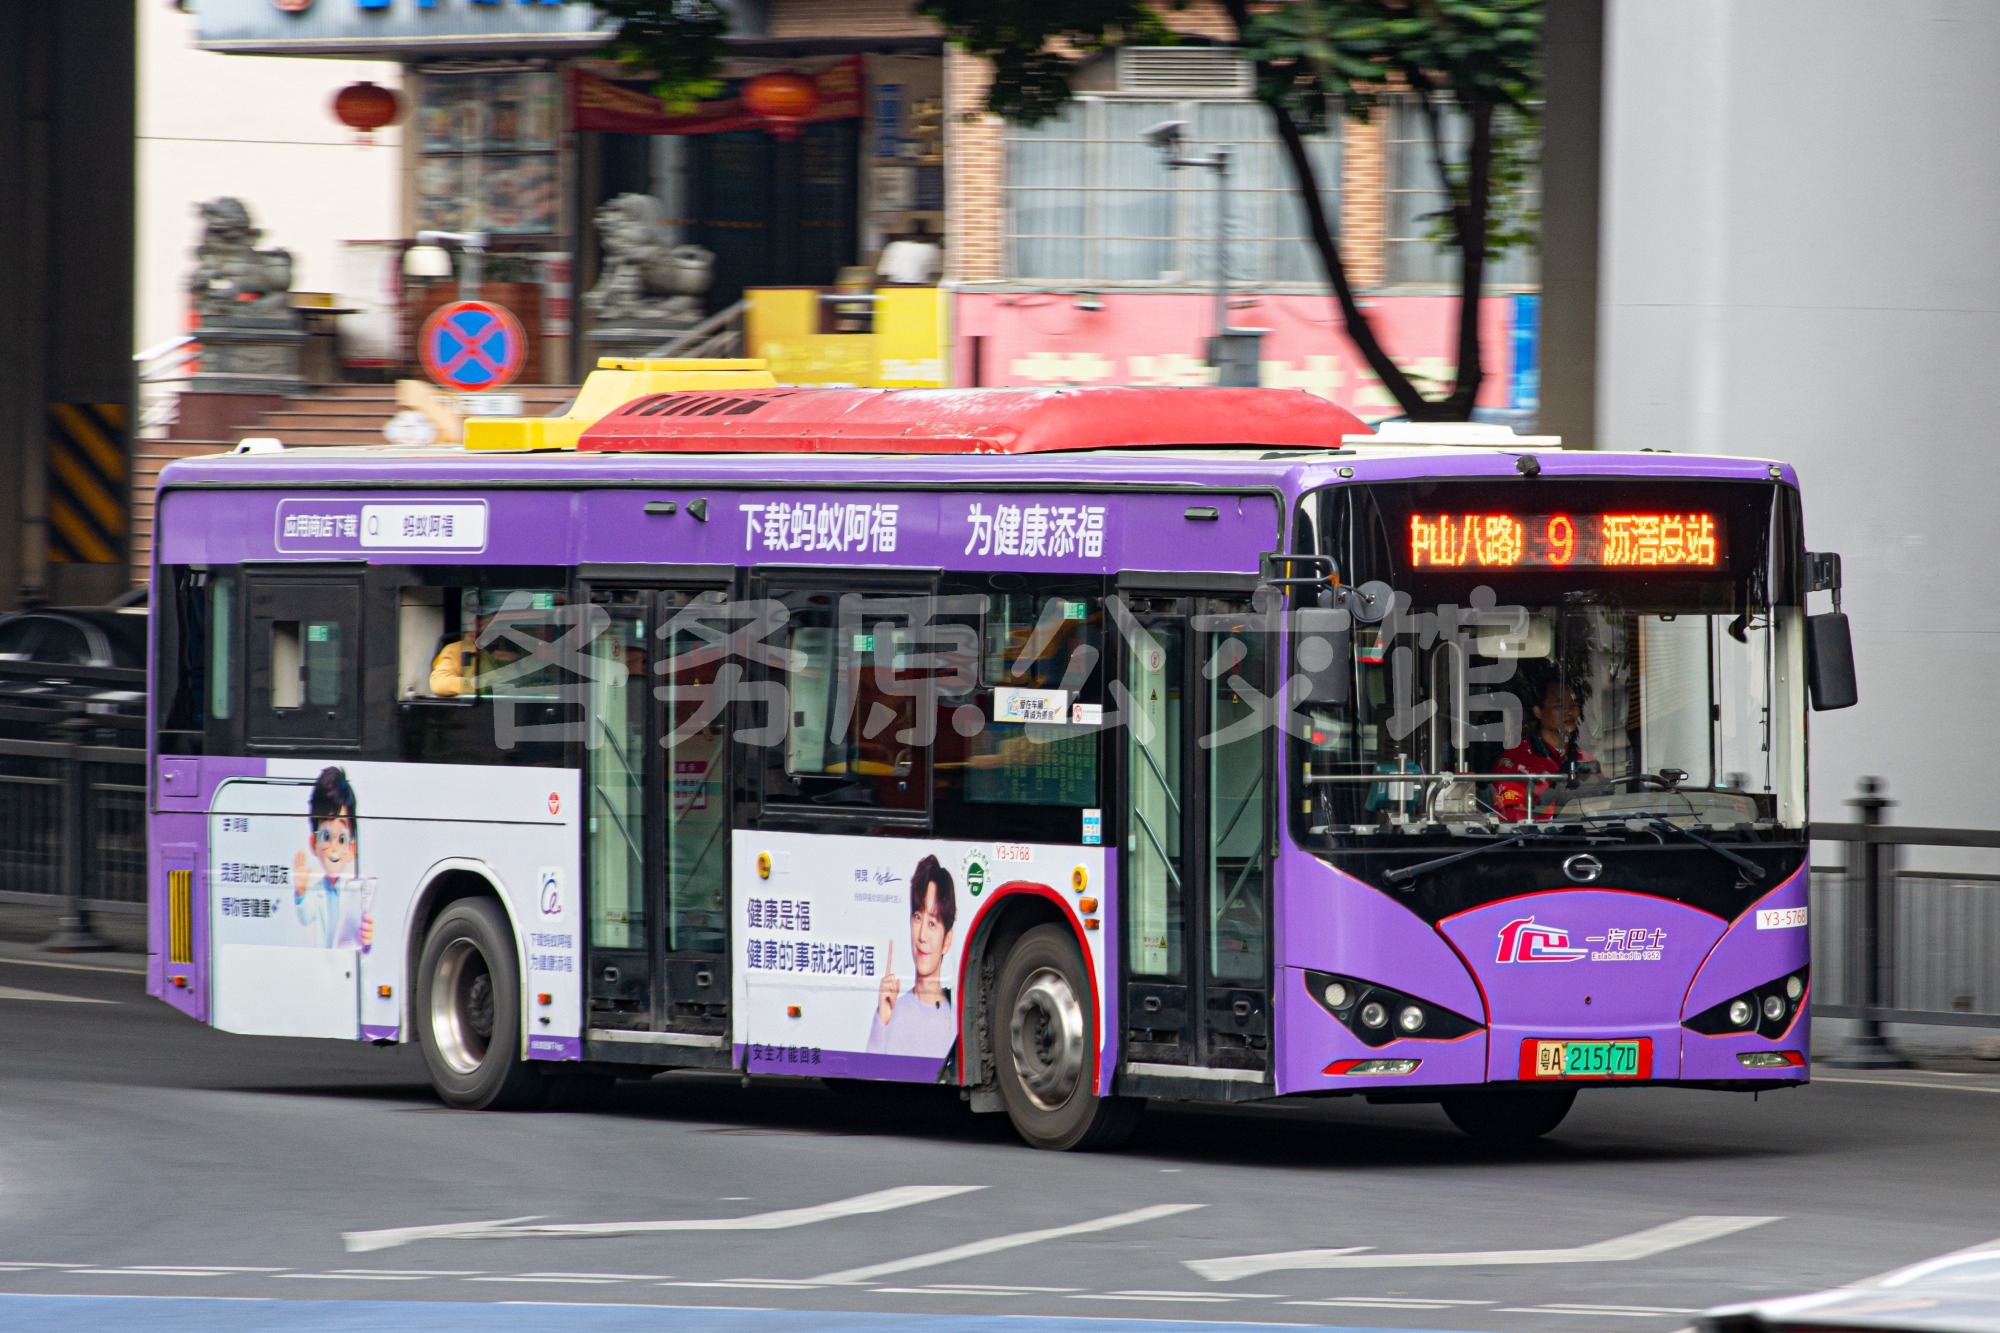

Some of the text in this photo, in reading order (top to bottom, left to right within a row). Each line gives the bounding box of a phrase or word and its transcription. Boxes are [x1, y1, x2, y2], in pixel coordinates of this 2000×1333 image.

[284, 514, 454, 537] 应用商店下载 蚂蚁阿福
[739, 501, 1106, 558] 下载蚂蚁阿福 为健康添福
[1548, 516, 1573, 565] 9
[1602, 515, 1715, 565] 沥滘总站
[996, 845, 1030, 861] Y3-5768
[221, 863, 289, 885] 我是你的AI朋友
[221, 897, 270, 918] 帮你管健康
[747, 897, 810, 931] 健康是福
[1764, 909, 1805, 926] Y3-5768
[529, 932, 572, 949] 下载蚂蚁阿福
[1586, 928, 1667, 951] 一汽巴士
[529, 953, 572, 973] 为健康添福
[747, 938, 875, 976] 健康的事就找阿福
[1592, 952, 1633, 961] Established
[1643, 951, 1661, 960] 1952
[753, 1042, 821, 1065] 安全才能回家
[1540, 1047, 1637, 1070] 粤A 21517D
